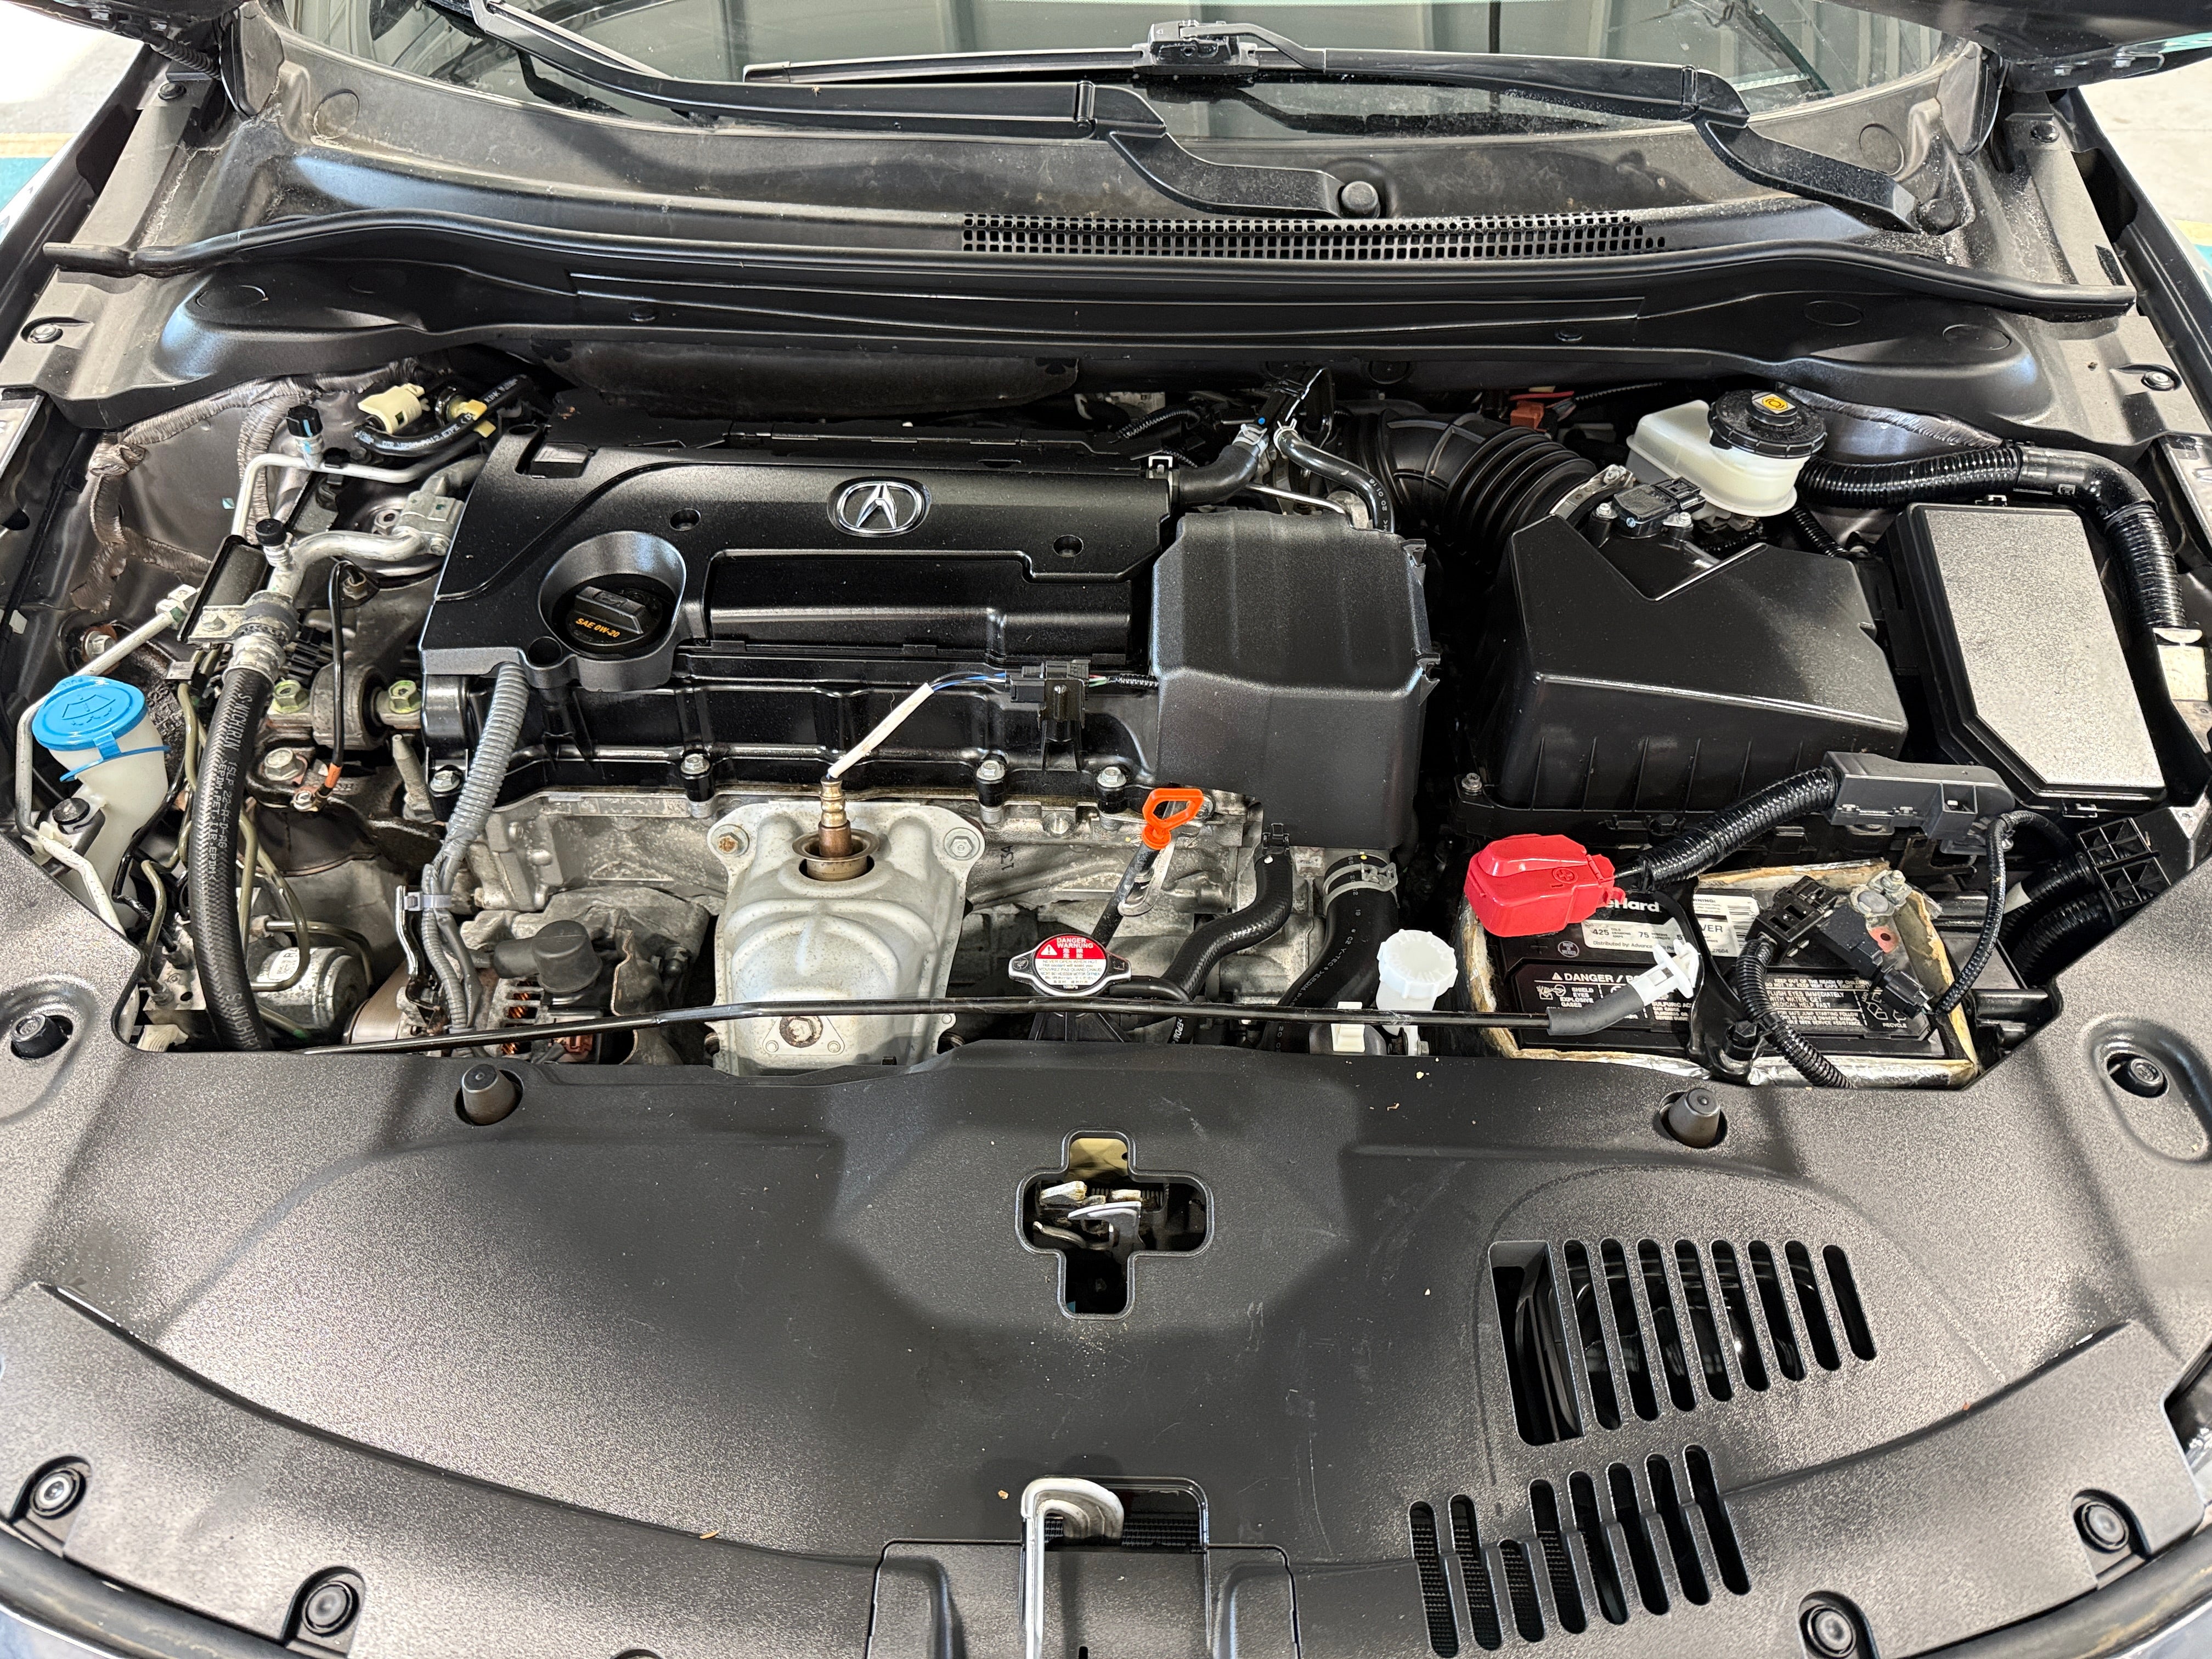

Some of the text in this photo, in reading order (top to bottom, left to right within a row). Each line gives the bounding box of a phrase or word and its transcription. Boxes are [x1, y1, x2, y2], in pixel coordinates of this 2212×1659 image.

[575, 618, 594, 629] SAE
[594, 624, 620, 638] 0W-20
[1605, 898, 1661, 913] eHard
[1702, 924, 1723, 933] VER
[1564, 973, 1614, 983] DANGER
